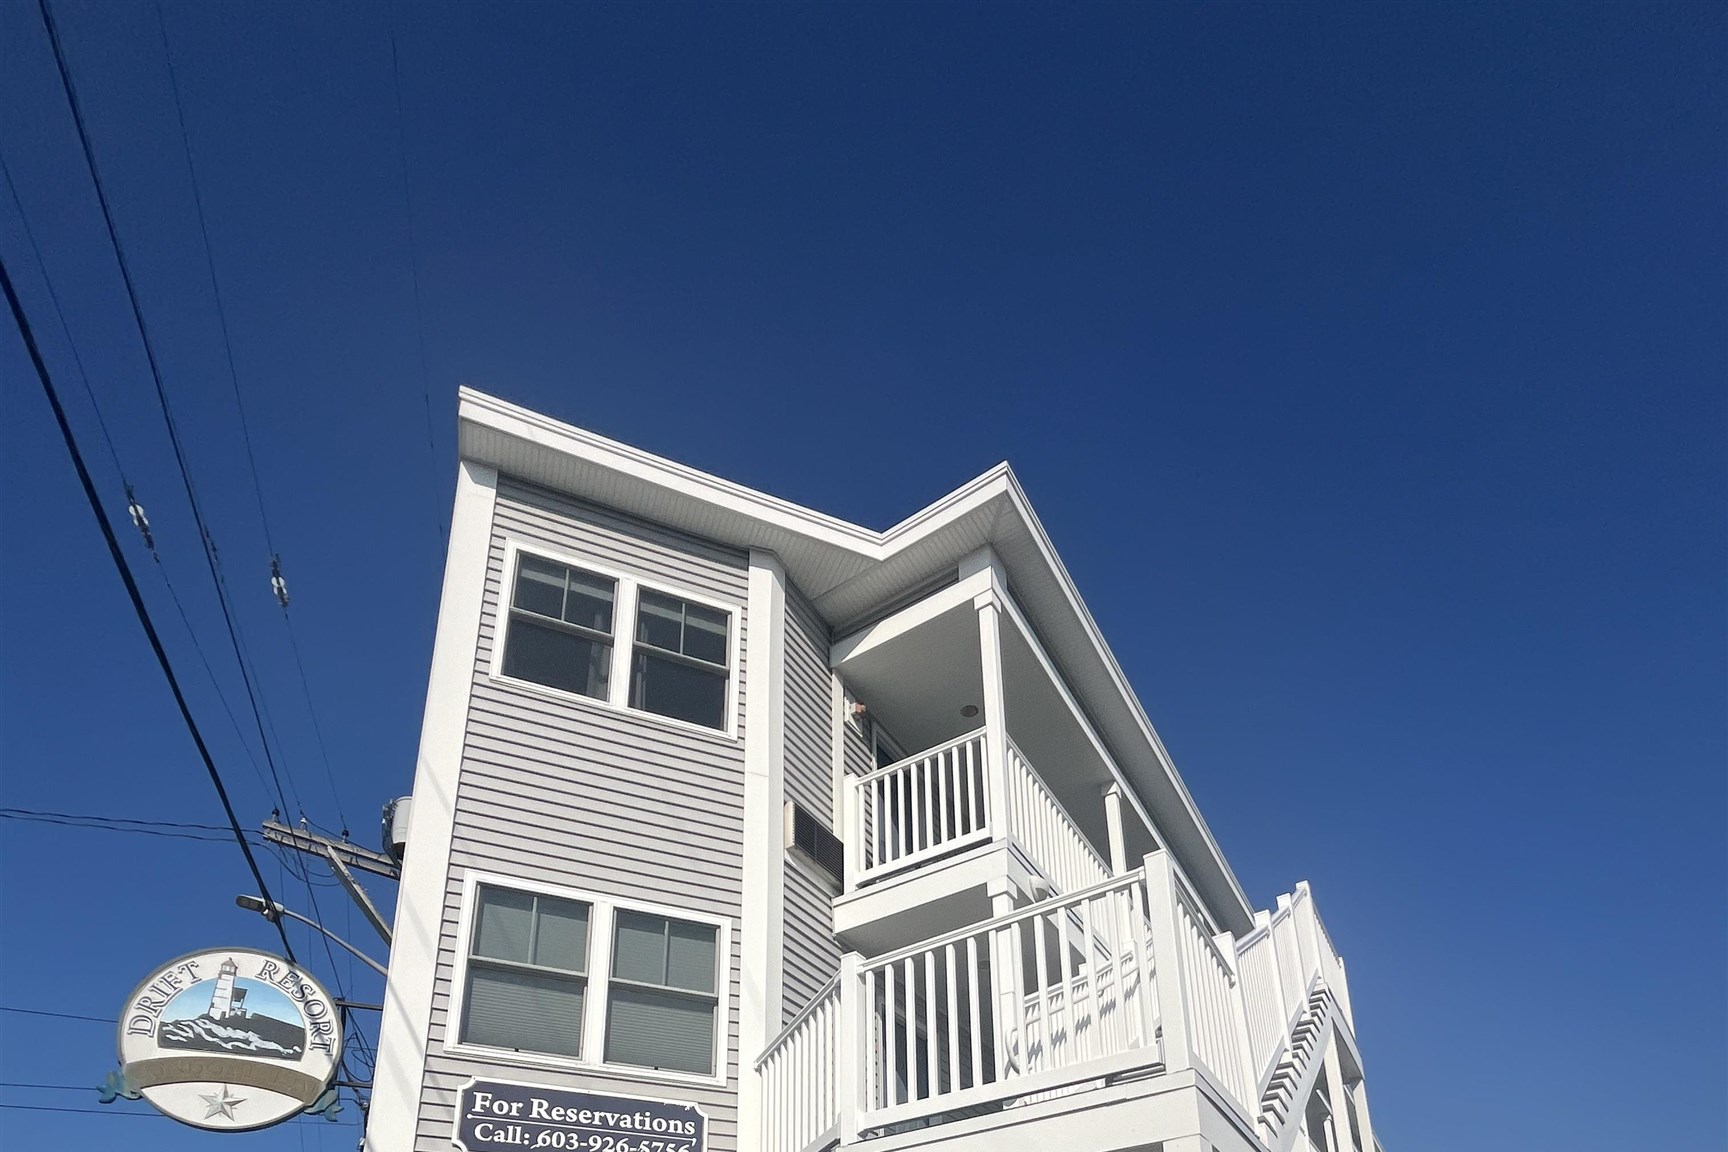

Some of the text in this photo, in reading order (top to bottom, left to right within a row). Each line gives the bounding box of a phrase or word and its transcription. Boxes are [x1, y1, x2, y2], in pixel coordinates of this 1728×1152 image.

[126, 959, 336, 1057] DRIFT RESORT
[471, 1091, 696, 1135] For Reservations
[474, 1122, 530, 1146] Call:
